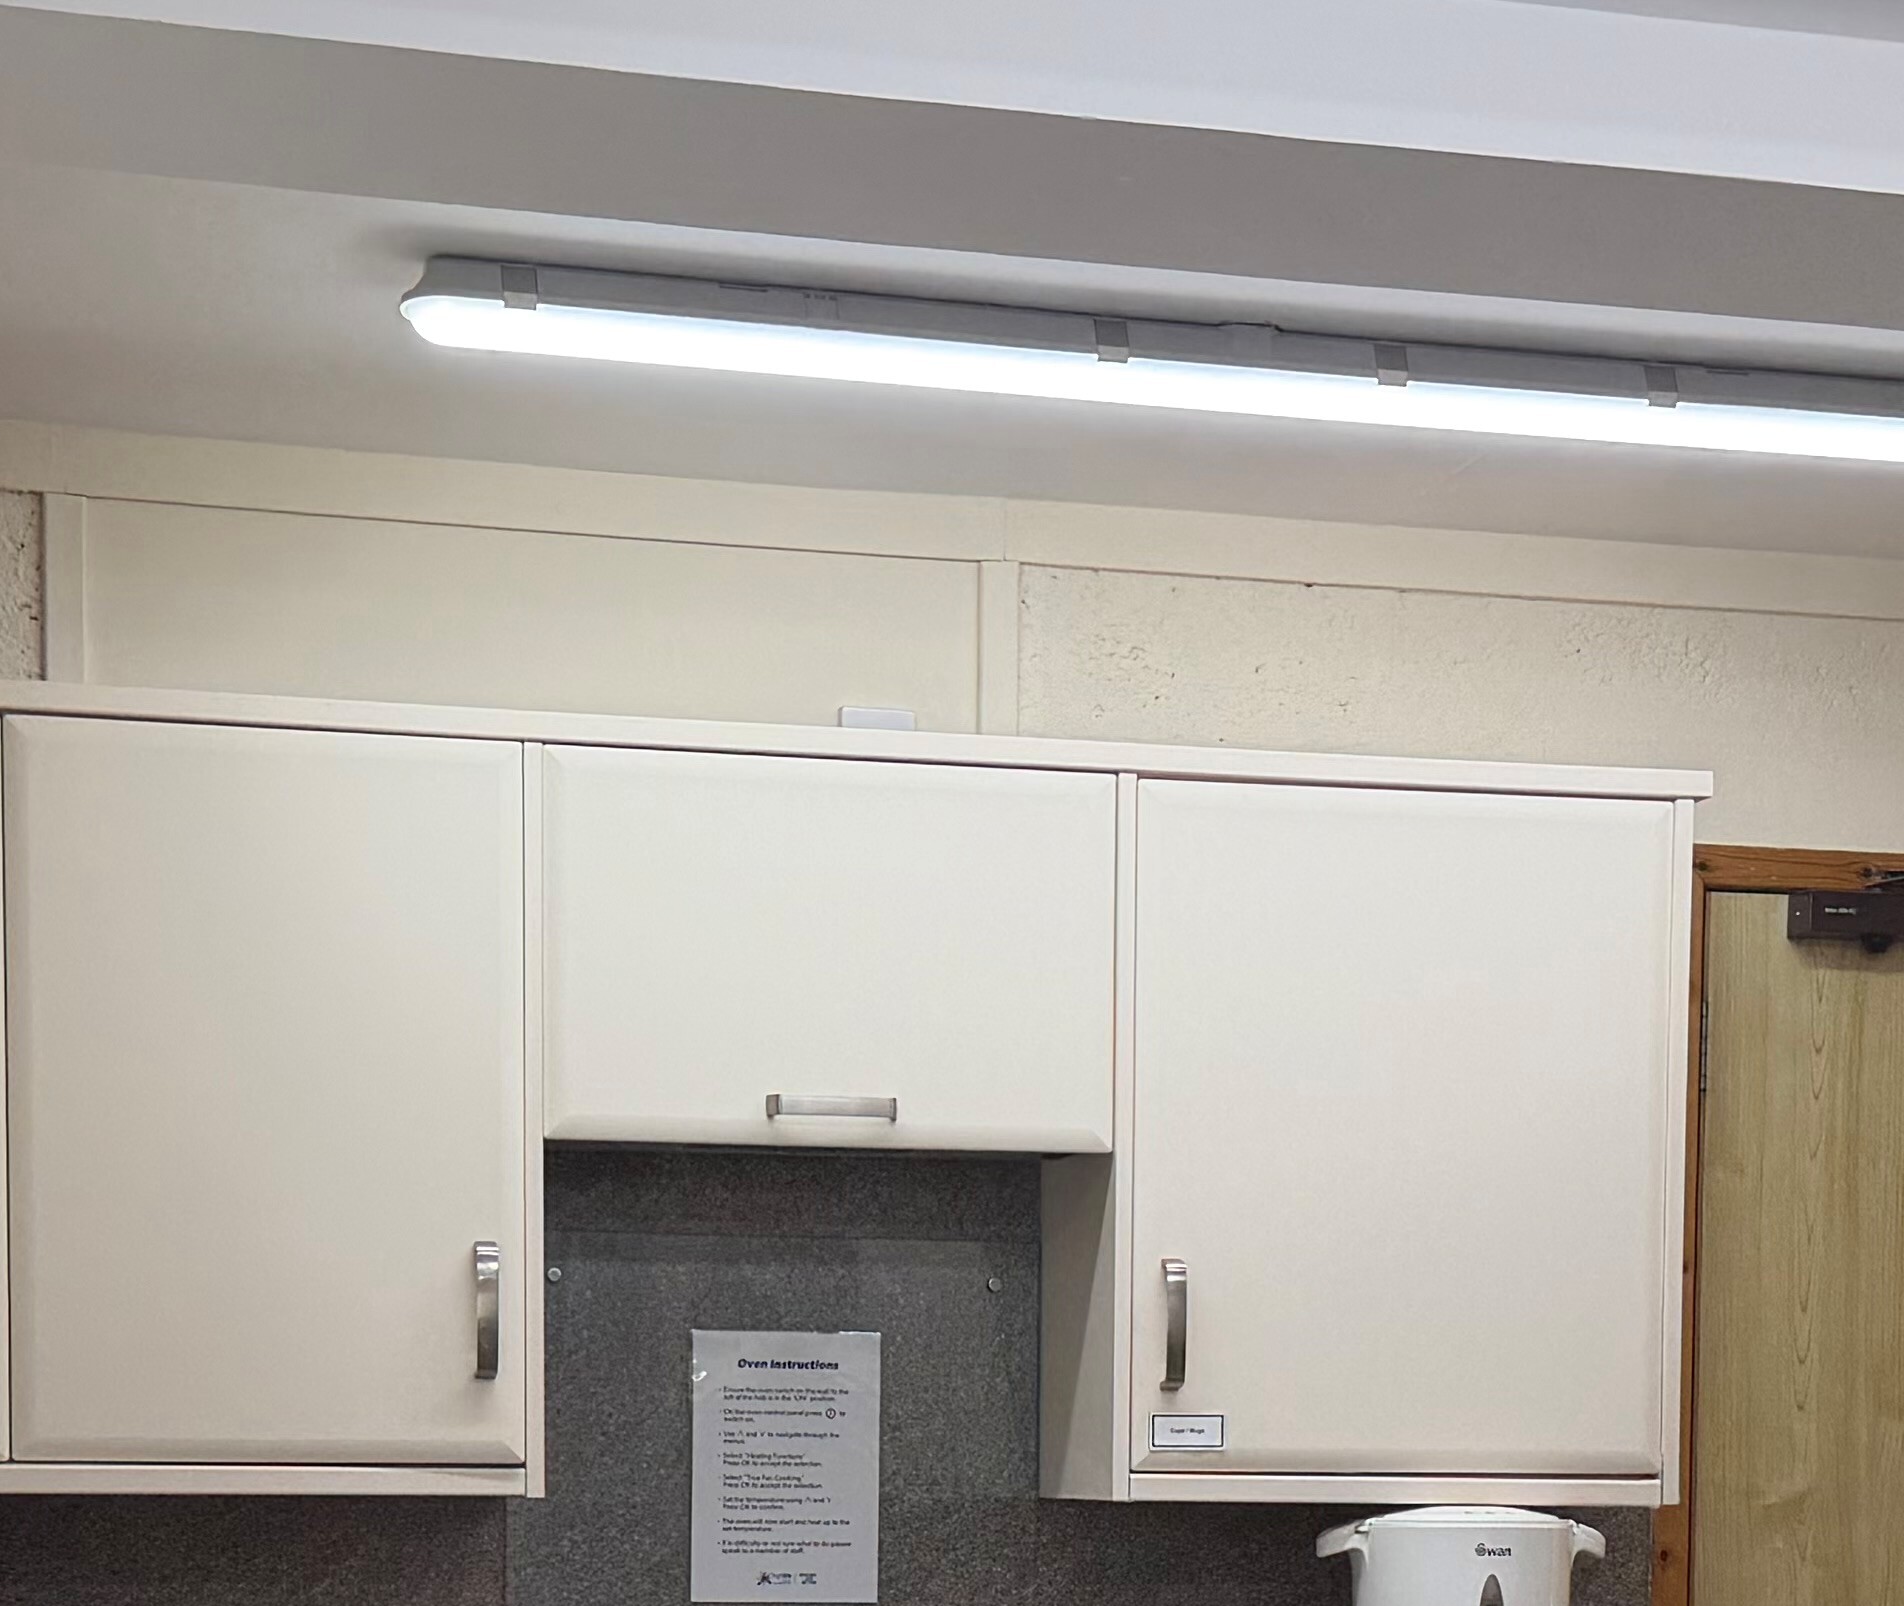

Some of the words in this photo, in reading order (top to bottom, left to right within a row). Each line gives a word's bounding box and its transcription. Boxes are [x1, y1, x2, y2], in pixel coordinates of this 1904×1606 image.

[737, 1358, 768, 1369] Oven
[770, 1359, 839, 1370] Instructions
[1475, 1543, 1511, 1556] Swan
